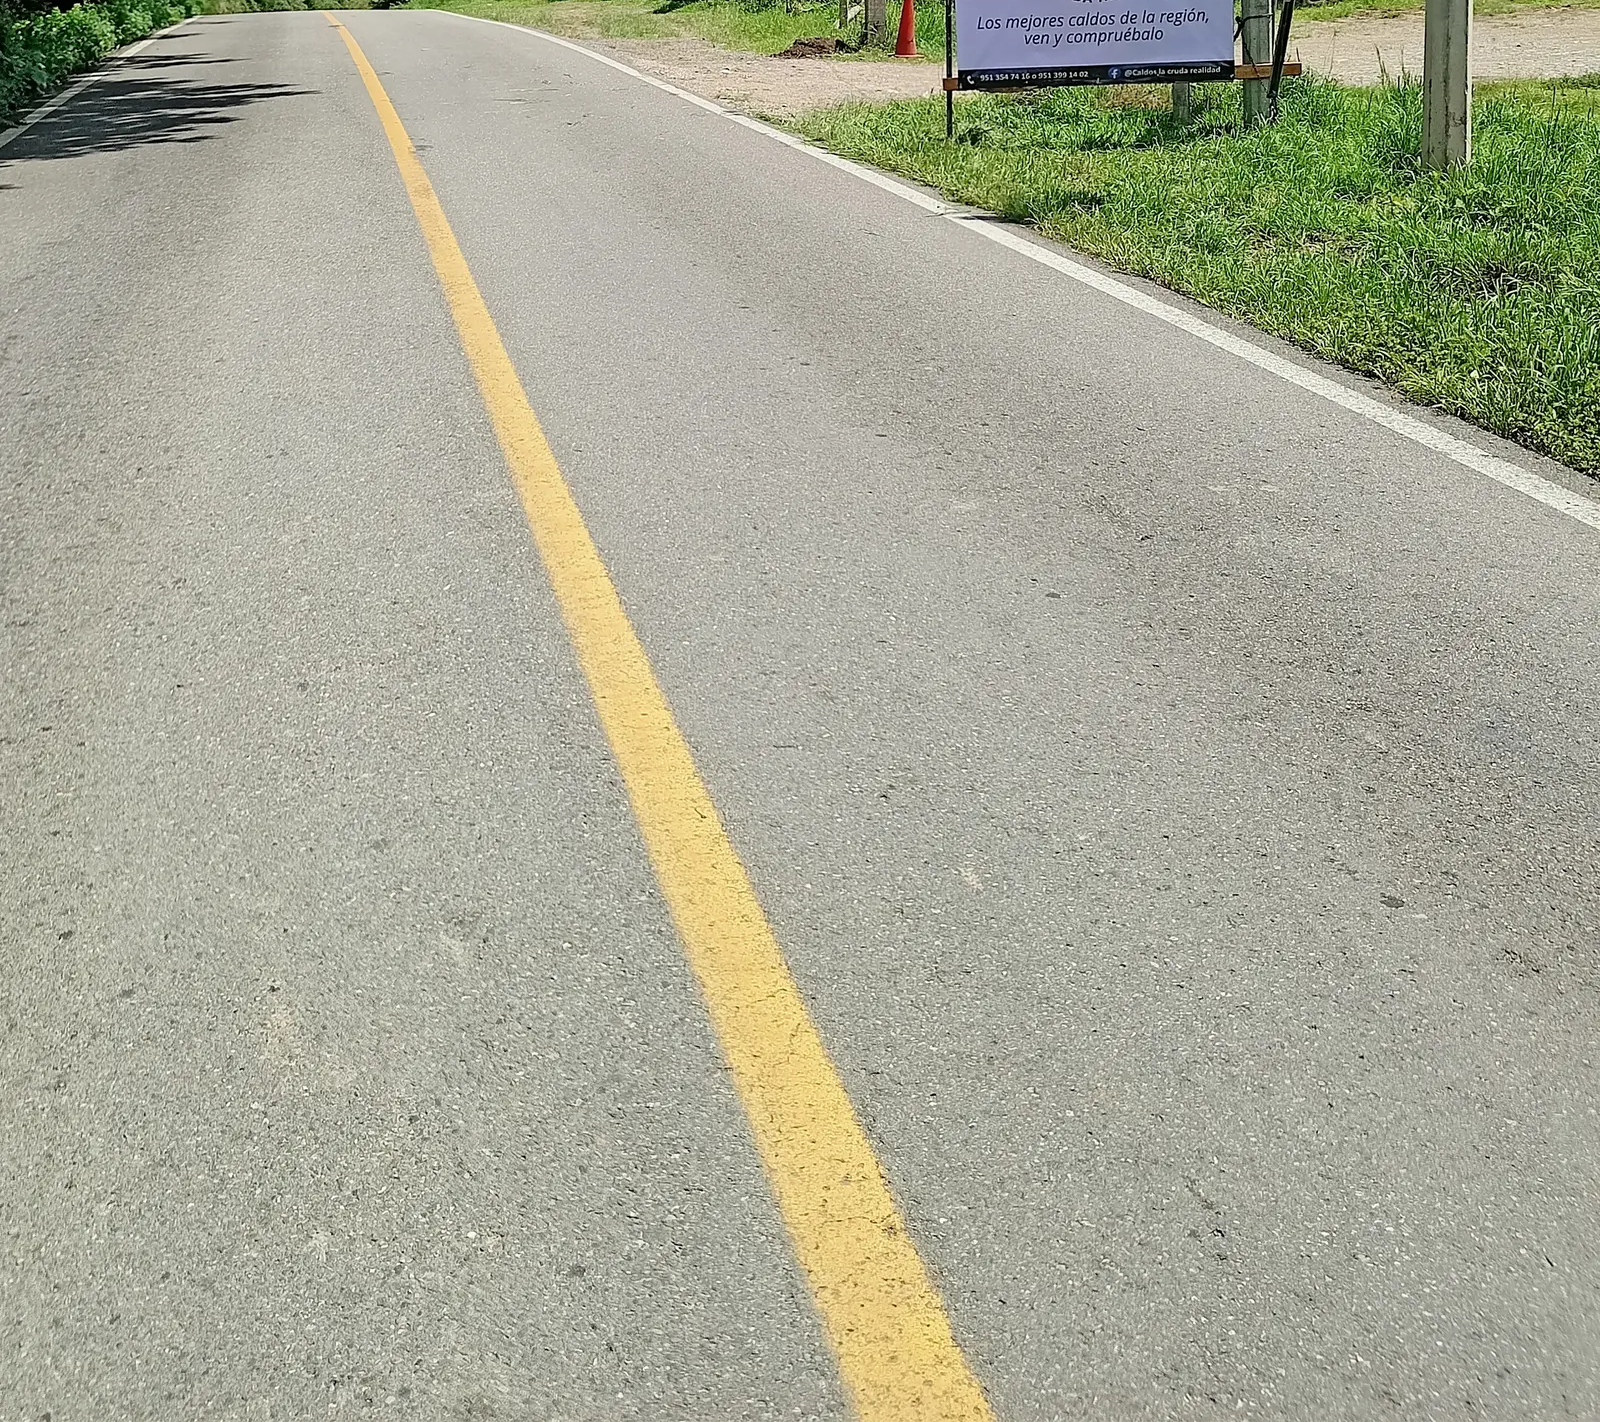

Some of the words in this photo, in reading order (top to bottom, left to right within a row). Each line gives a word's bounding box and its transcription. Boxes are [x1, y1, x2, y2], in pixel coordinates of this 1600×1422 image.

[977, 16, 1001, 30] Los
[1006, 15, 1064, 33] mejores
[1068, 11, 1116, 27] caldos
[1120, 10, 1138, 25] de
[1142, 10, 1156, 24] la
[1159, 8, 1210, 26] región,
[1024, 34, 1050, 45] ven
[1052, 34, 1063, 48] y
[1066, 26, 1164, 46] compruébalo
[980, 74, 994, 82] 951
[995, 73, 1009, 81] 354
[1010, 73, 1020, 81] 74
[1038, 72, 1052, 80] 951
[1053, 71, 1067, 79] 399
[1167, 67, 1189, 75] cruda
[1190, 66, 1221, 74] realidad
